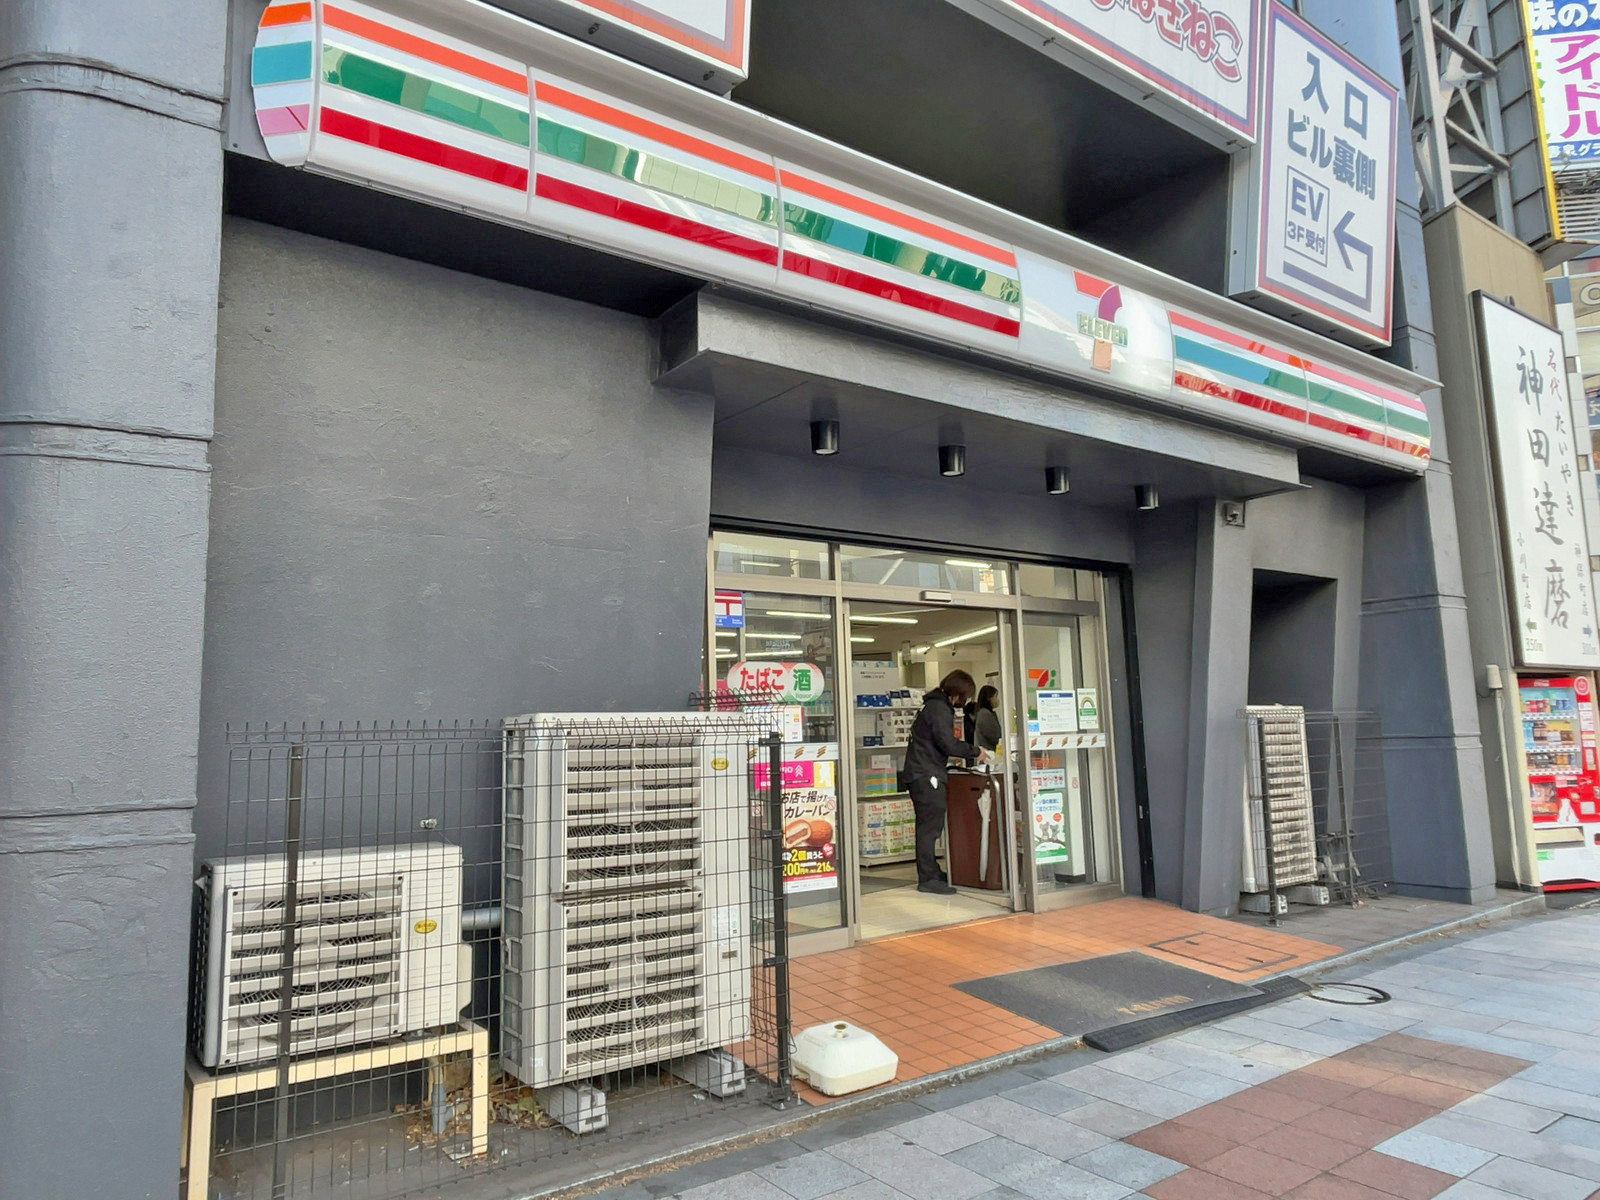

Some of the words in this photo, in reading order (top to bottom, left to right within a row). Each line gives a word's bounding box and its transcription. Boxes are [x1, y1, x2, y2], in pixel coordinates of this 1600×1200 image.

[1091, 0, 1242, 82] きねこ
[1301, 51, 1368, 140] 入口
[1550, 34, 1600, 139] アイドル
[1287, 107, 1376, 200] ビル裏側
[1287, 221, 1326, 255] 3F受付
[1292, 177, 1324, 222] EV
[1516, 345, 1571, 629] 神田達磨
[740, 667, 785, 691] たばこ
[793, 668, 811, 691] 酒
